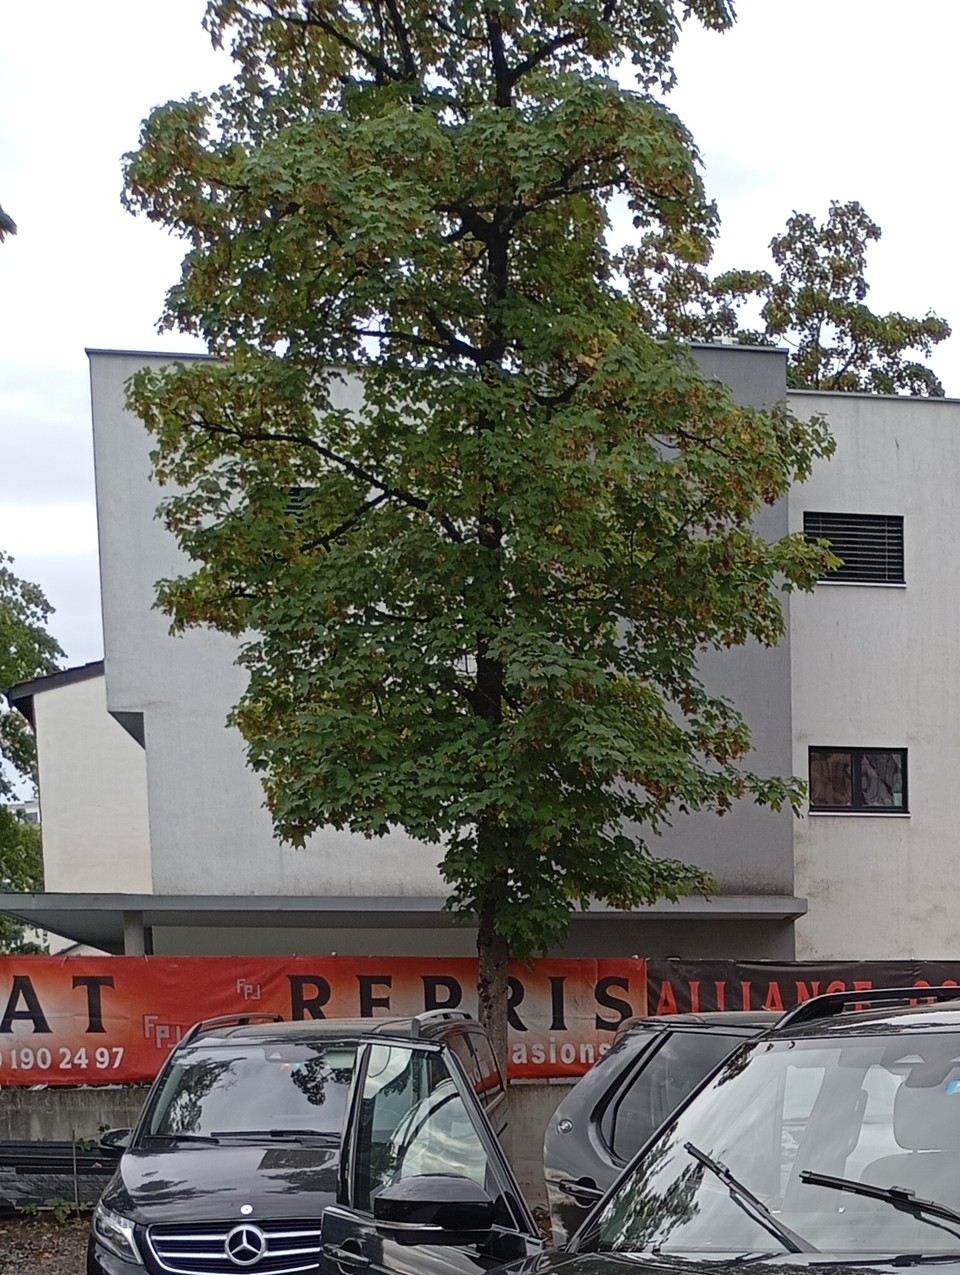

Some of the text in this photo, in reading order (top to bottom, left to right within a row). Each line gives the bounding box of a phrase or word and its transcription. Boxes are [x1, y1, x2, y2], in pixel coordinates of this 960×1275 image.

[288, 975, 633, 1031] REPRIS
[10, 1047, 52, 1069] 190
[59, 1047, 89, 1069] 24
[95, 1047, 125, 1069] 97
